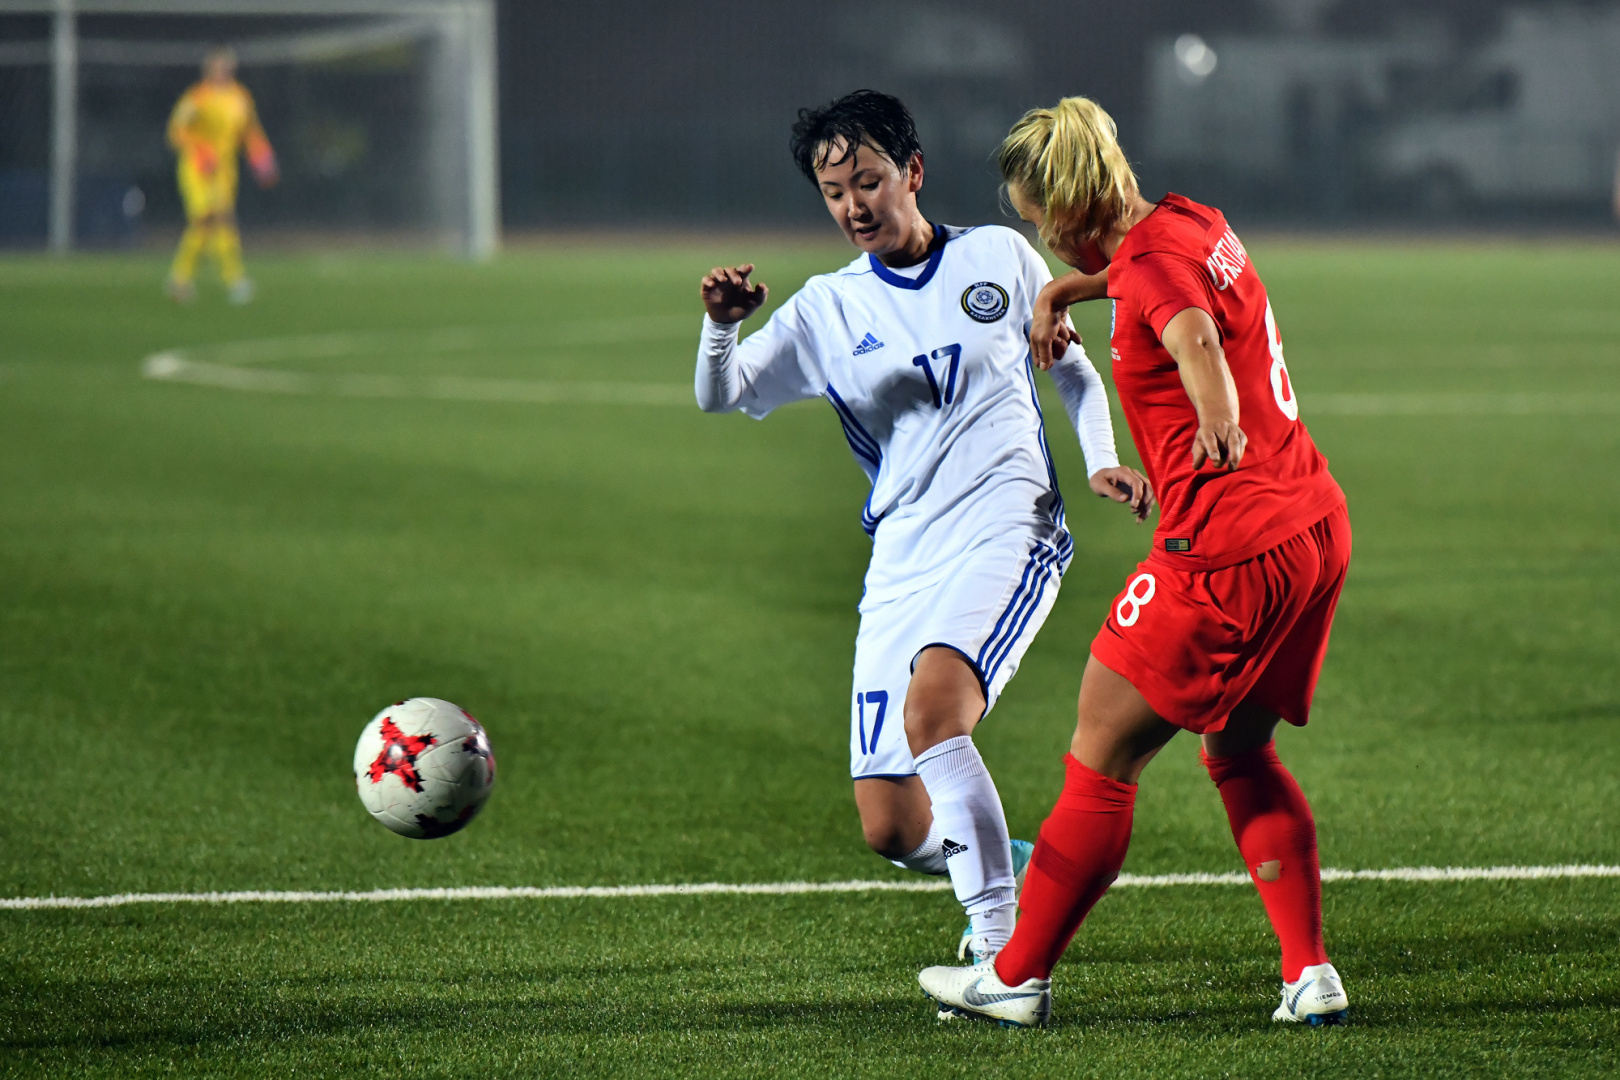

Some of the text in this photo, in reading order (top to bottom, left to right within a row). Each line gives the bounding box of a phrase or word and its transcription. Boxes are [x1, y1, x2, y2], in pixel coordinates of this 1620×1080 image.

[852, 341, 885, 357] adidas
[912, 343, 962, 409] 17
[1265, 295, 1299, 421] 8
[1117, 573, 1156, 627] 8
[857, 690, 889, 756] 17
